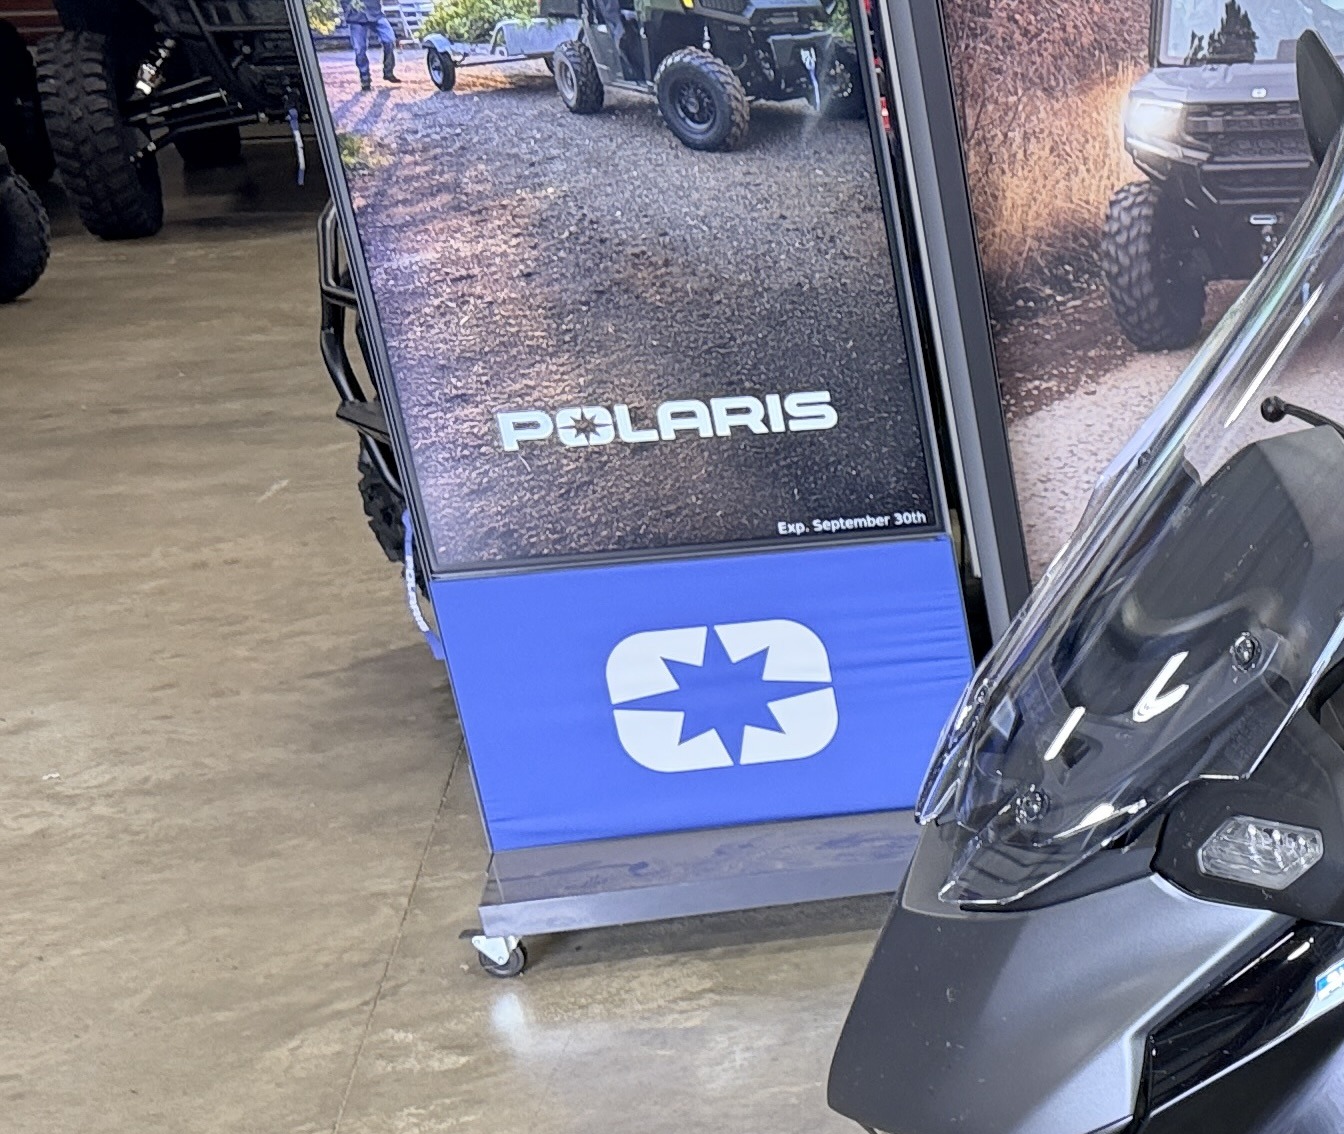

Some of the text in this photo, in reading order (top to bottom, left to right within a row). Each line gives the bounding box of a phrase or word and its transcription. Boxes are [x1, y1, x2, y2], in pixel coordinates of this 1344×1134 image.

[497, 391, 839, 452] POLARIS
[777, 511, 927, 536] Exp. September 30th
